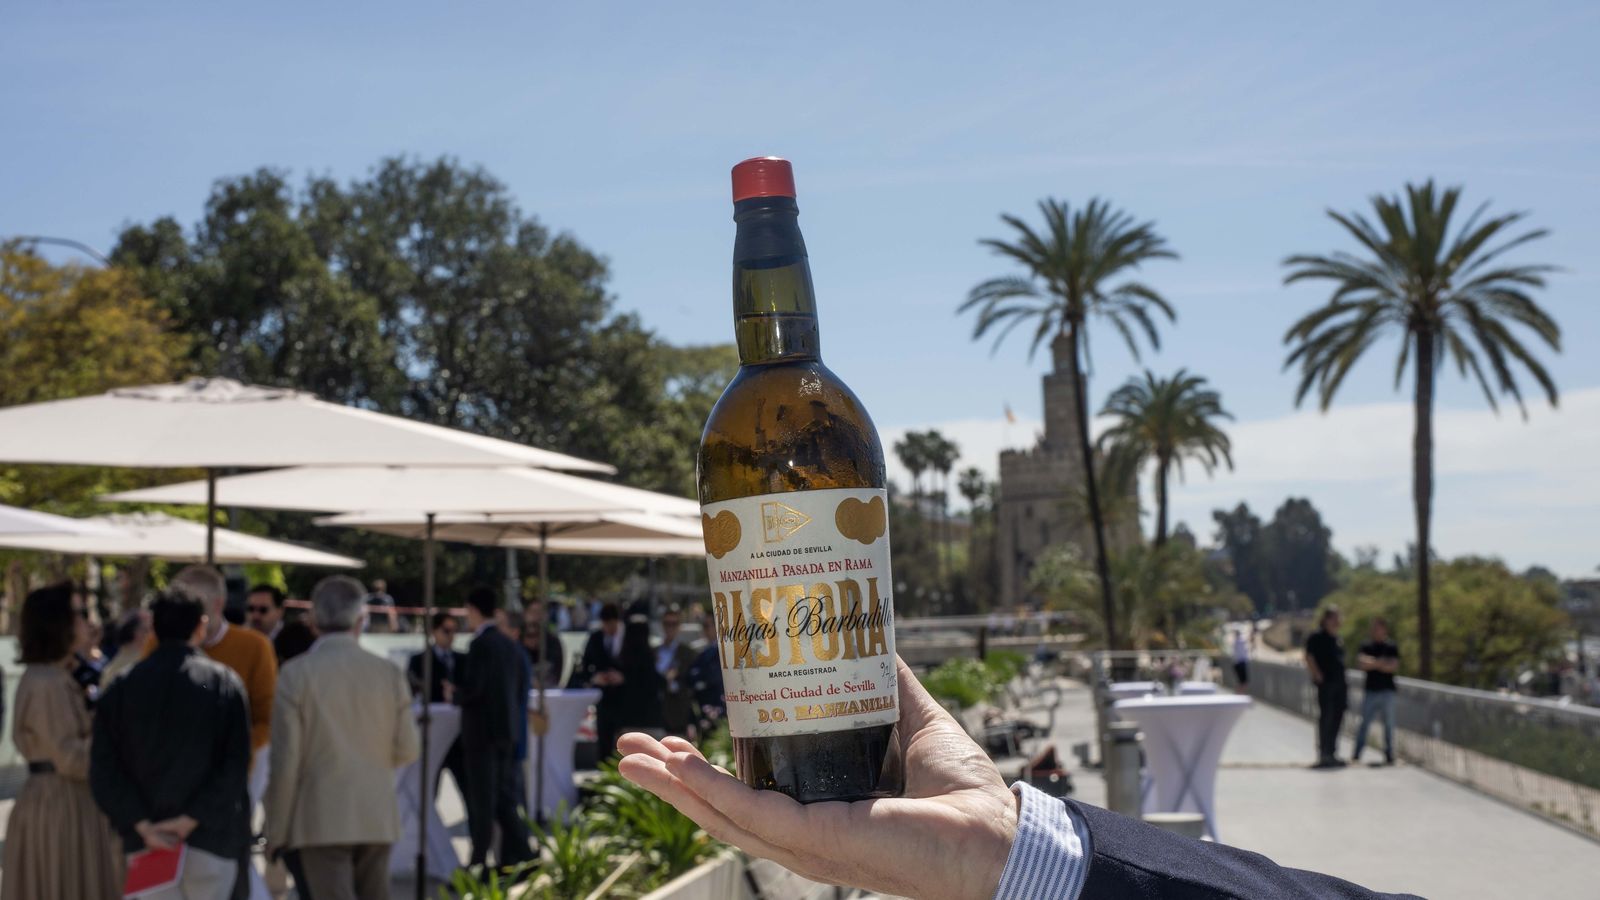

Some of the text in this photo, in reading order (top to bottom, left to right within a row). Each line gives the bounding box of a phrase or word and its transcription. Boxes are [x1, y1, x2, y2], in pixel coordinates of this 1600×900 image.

[766, 549, 791, 557] CIUDAD
[793, 547, 802, 555] DE
[804, 545, 833, 554] SEVILLA
[720, 558, 872, 582] MANZANILLA PASADA EN RAMA
[714, 577, 888, 669] PASTORA
[769, 667, 837, 678] MARCA REGISTRADA
[740, 690, 777, 704] Especial
[781, 685, 823, 700] Ciudad
[826, 683, 841, 695] de
[843, 680, 876, 694] Sevilla
[757, 695, 896, 723] D.O. MANZANILLA
